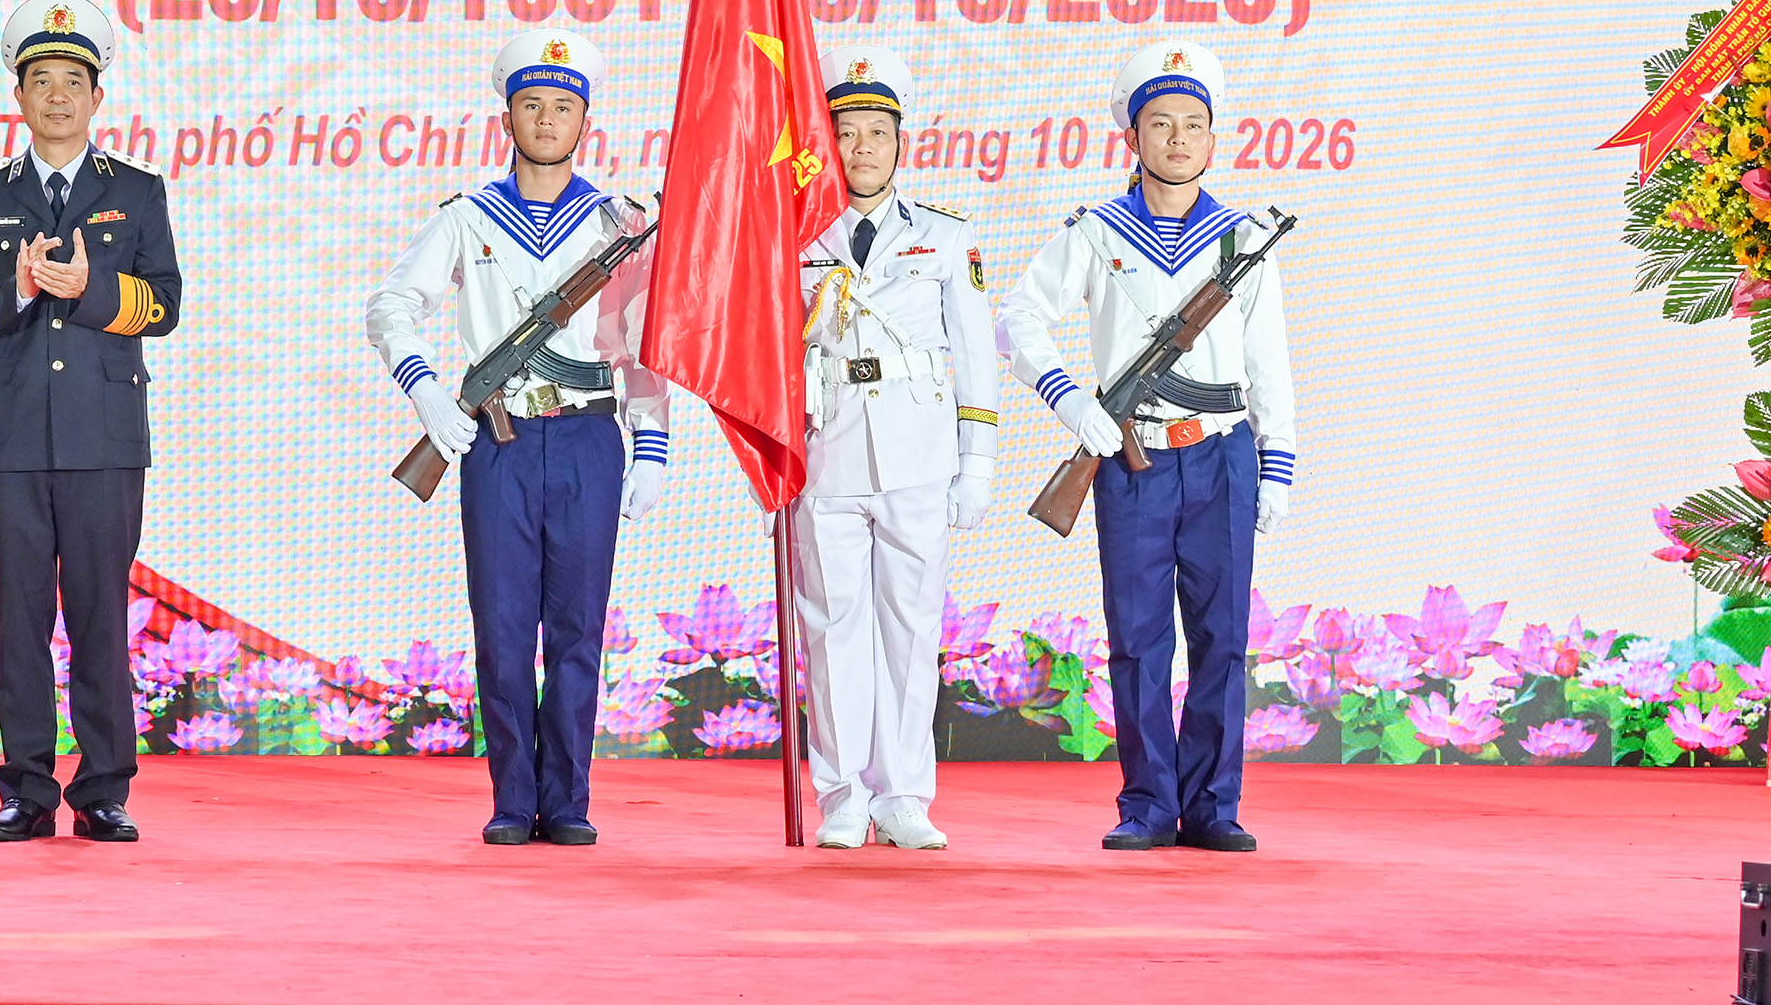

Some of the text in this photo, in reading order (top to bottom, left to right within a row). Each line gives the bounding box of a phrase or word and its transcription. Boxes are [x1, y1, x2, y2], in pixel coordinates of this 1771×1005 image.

[1648, 89, 1675, 117] THÀNH
[1691, 56, 1707, 72] HỘI
[1705, 34, 1728, 57] ĐỒNG
[1725, 10, 1748, 34] NHÂN
[1727, 28, 1749, 49] TRẬN
[171, 122, 273, 179] phố
[291, 116, 361, 167] Hồ
[381, 116, 474, 167] Chí
[896, 115, 1010, 183] áng
[1037, 119, 1087, 167] 10
[1235, 119, 1354, 169] 2026
[792, 148, 823, 196] 25
